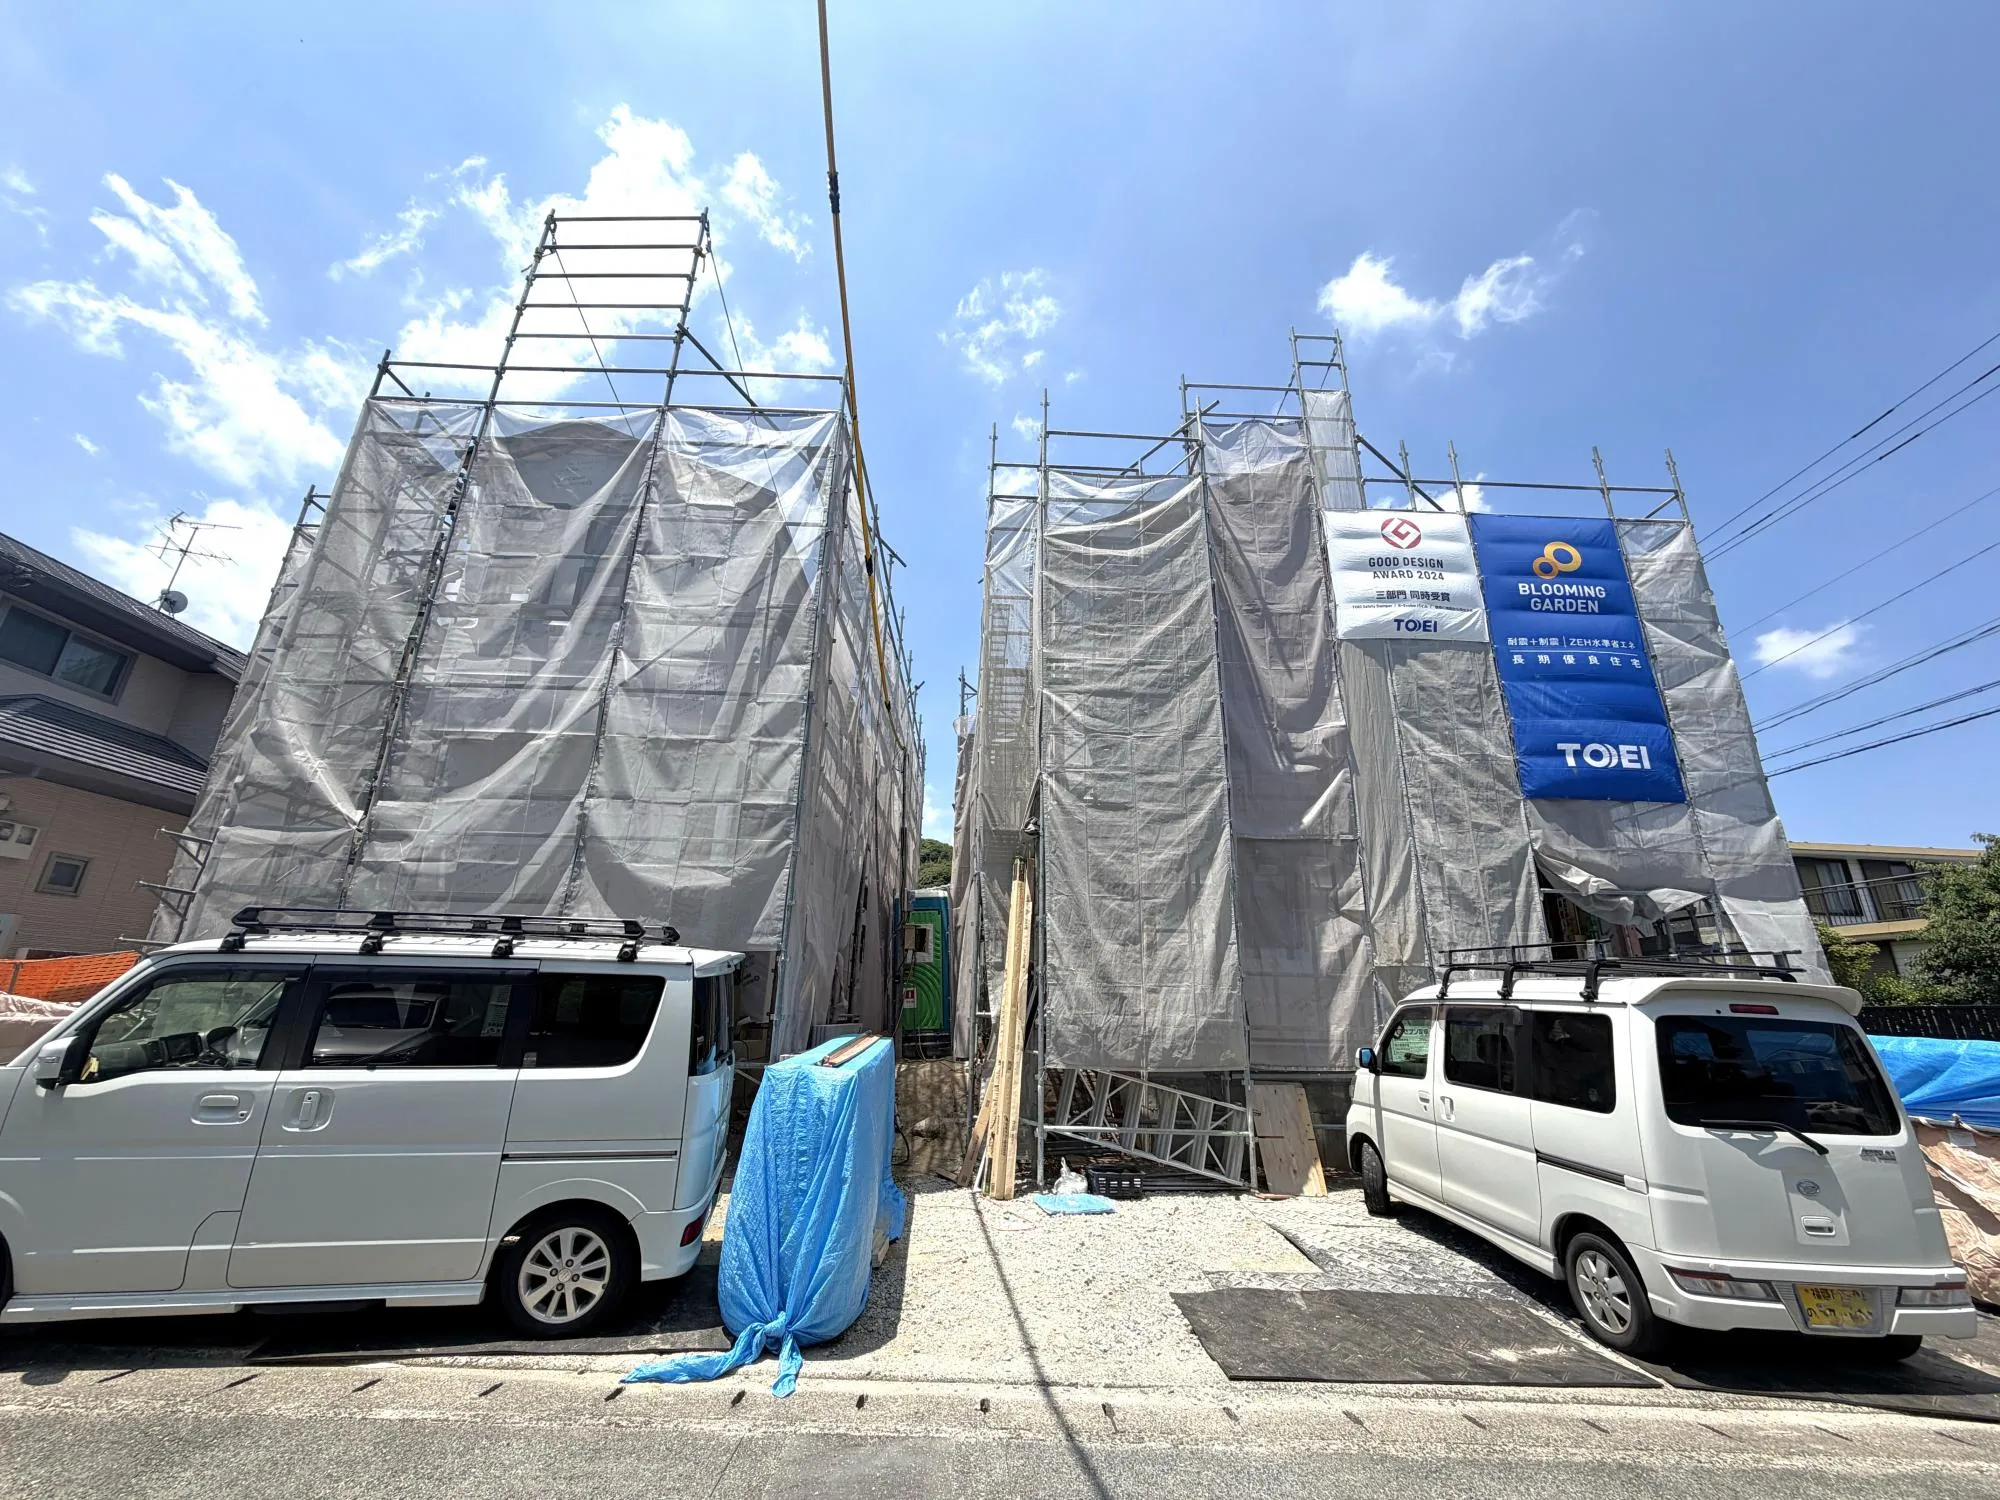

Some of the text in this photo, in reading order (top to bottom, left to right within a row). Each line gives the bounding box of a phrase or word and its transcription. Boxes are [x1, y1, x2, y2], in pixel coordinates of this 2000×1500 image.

[1368, 557, 1444, 569] GOOD DESIGN
[1373, 570, 1444, 581] AWARD 2024
[1375, 590, 1451, 602] 三部門 同時受賞
[1518, 583, 1606, 599] BLOOMING
[1530, 598, 1599, 613] GARDEN
[1394, 619, 1438, 632] TOEI
[1557, 743, 1652, 769] TOEI
